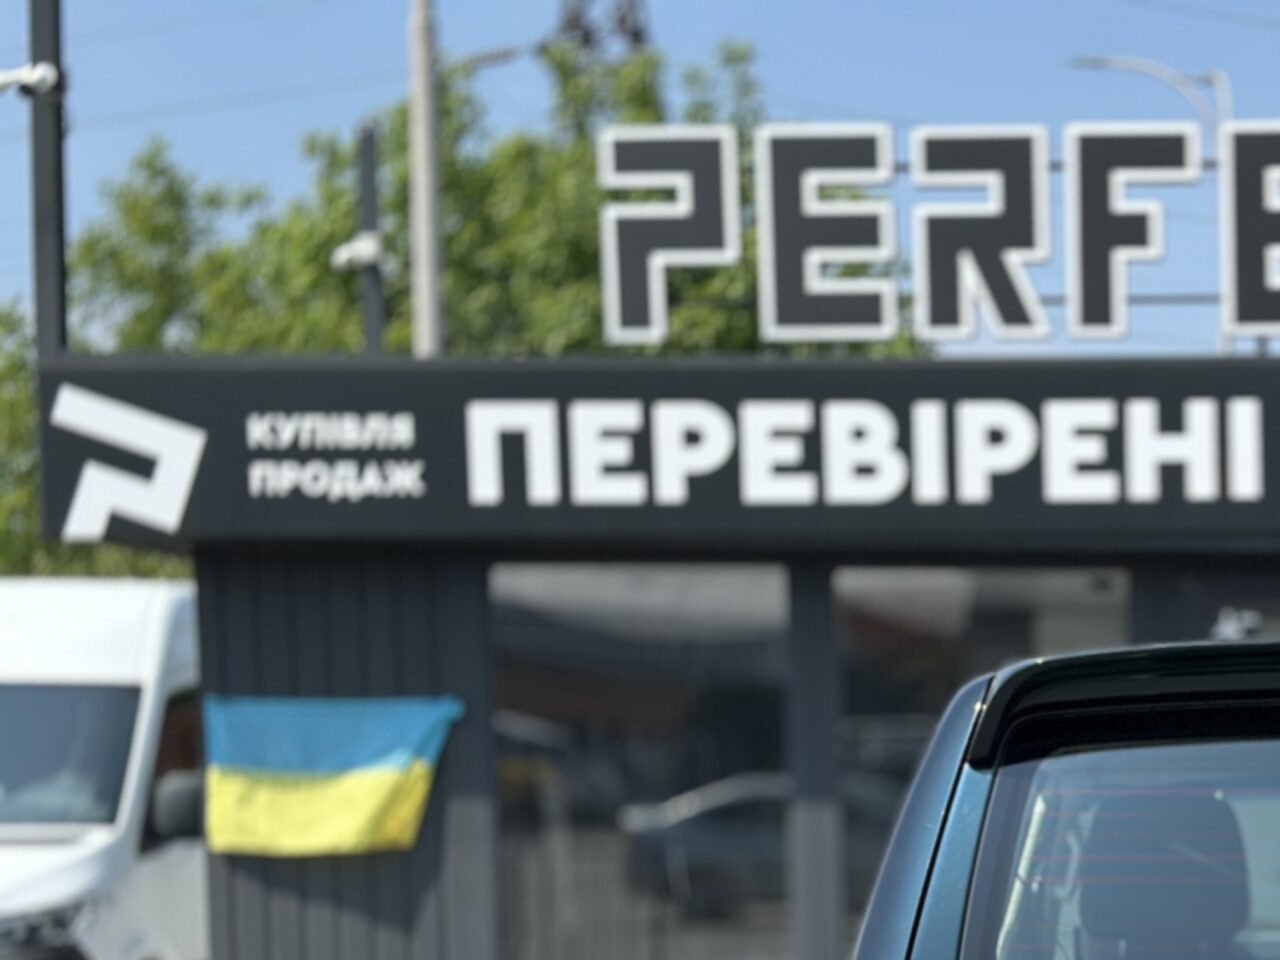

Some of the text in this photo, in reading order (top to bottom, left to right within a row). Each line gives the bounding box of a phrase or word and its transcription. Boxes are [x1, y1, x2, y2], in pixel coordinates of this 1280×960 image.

[246, 412, 414, 450] КУПІВЛЯ
[465, 396, 1265, 507] ПЕРЕВІРЕНІ
[248, 459, 426, 503] ПРОДАЖ
